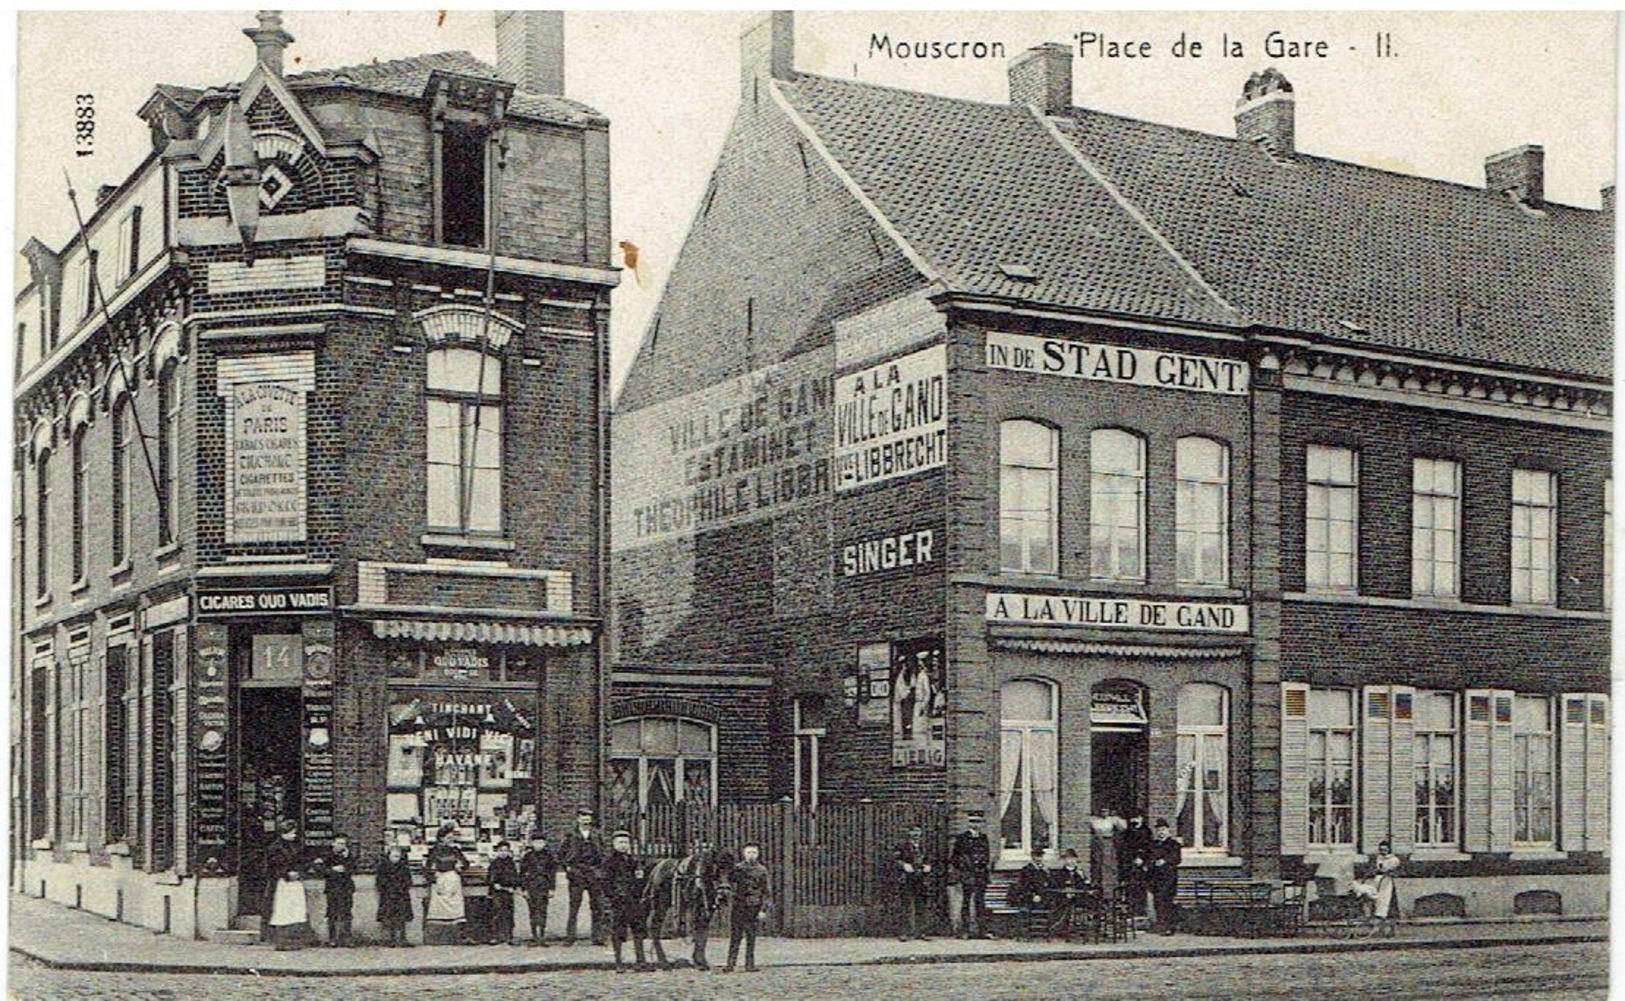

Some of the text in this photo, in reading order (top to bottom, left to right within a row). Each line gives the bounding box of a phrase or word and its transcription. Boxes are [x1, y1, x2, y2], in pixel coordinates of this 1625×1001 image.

[990, 344, 1008, 366] IN
[1014, 347, 1035, 369] DE
[1042, 340, 1138, 381] STAD
[779, 373, 835, 420] GAN
[854, 364, 900, 398] A LA
[242, 416, 289, 434] PARIS
[837, 394, 877, 447] VILLE
[891, 374, 944, 433] GAND
[685, 420, 816, 485] ESTAMINET
[855, 429, 946, 482] LIBBRECHT
[843, 530, 933, 577] SINGER
[259, 593, 287, 609] QUO
[289, 592, 329, 607] VADIS
[994, 597, 1235, 629] A LA VILLE DE GAND
[264, 645, 290, 669] 14
[408, 729, 439, 742] ENI
[446, 727, 478, 740] VIDI
[894, 748, 945, 766] LIEBIG
